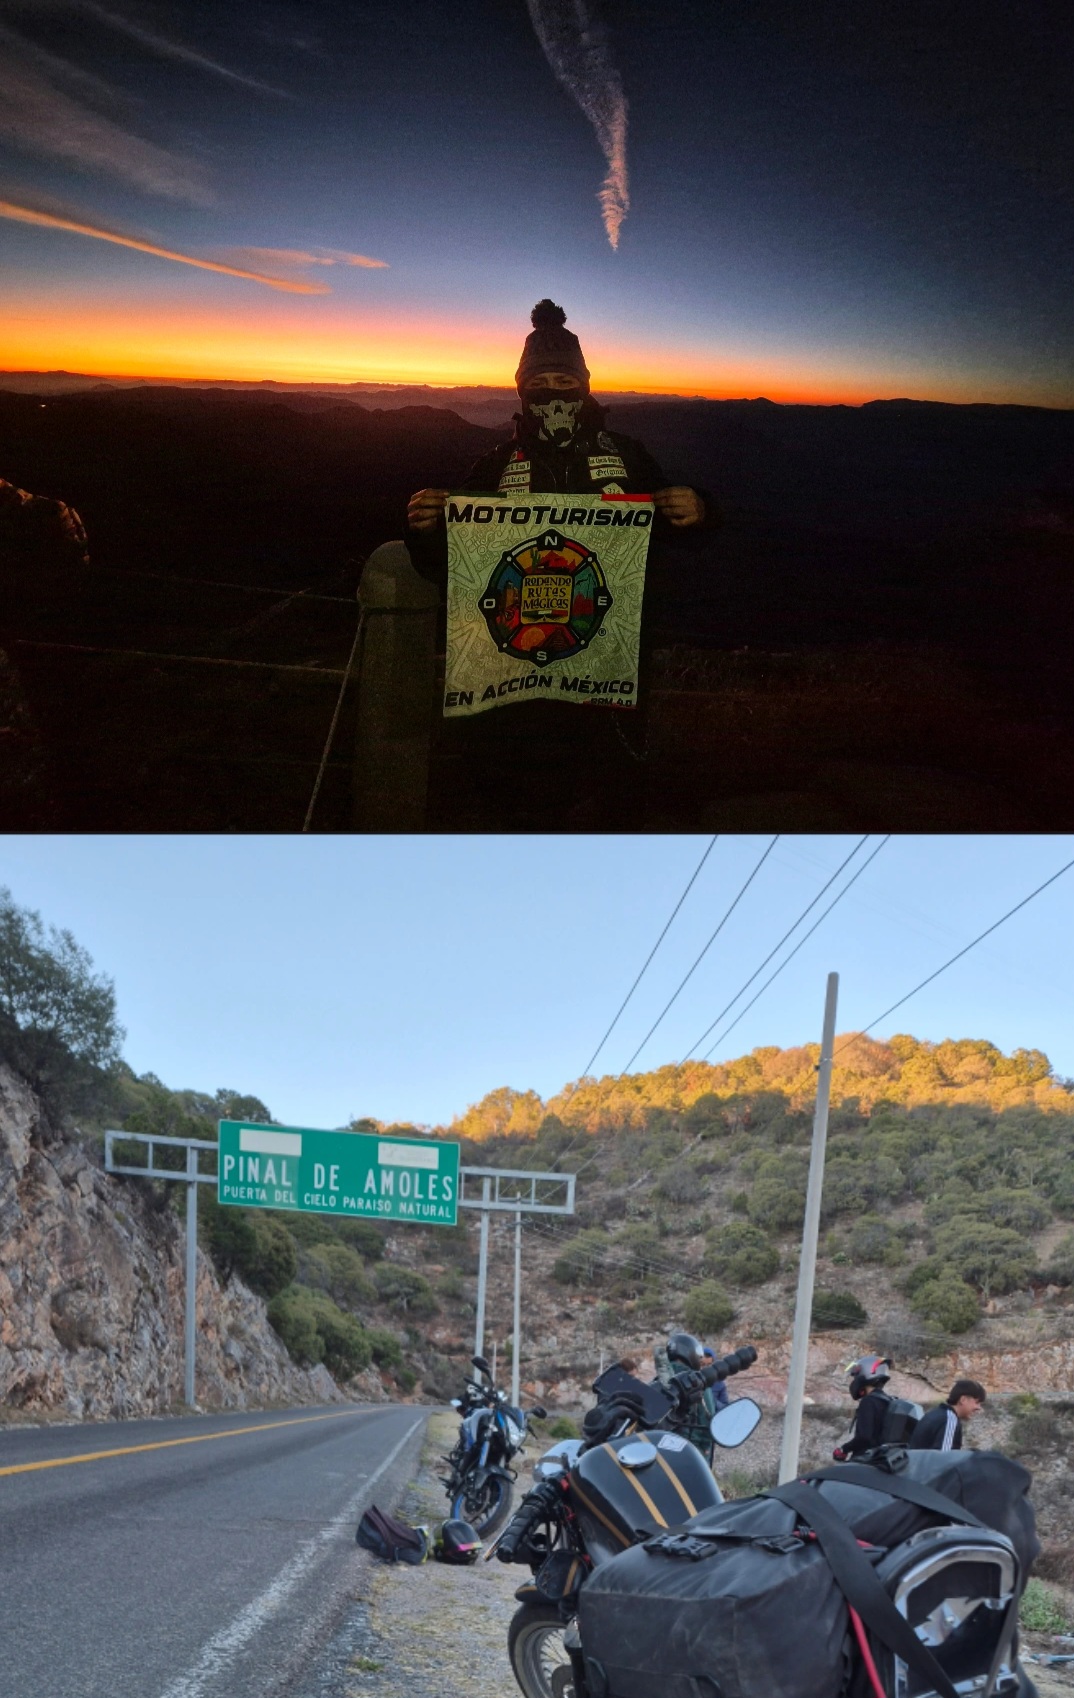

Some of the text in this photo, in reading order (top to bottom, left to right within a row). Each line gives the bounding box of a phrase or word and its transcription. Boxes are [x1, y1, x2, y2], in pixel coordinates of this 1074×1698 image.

[447, 502, 653, 527] MOTOTURISMO
[544, 535, 558, 546] N
[483, 598, 496, 609] O
[597, 596, 608, 606] E
[536, 651, 547, 661] S
[444, 670, 634, 707] EN ACCIÓN MÉXICO
[223, 1154, 453, 1201] PINAL DE AMOLES
[223, 1184, 452, 1218] PUERTA DEL CIELO PARAISO NATURAL
